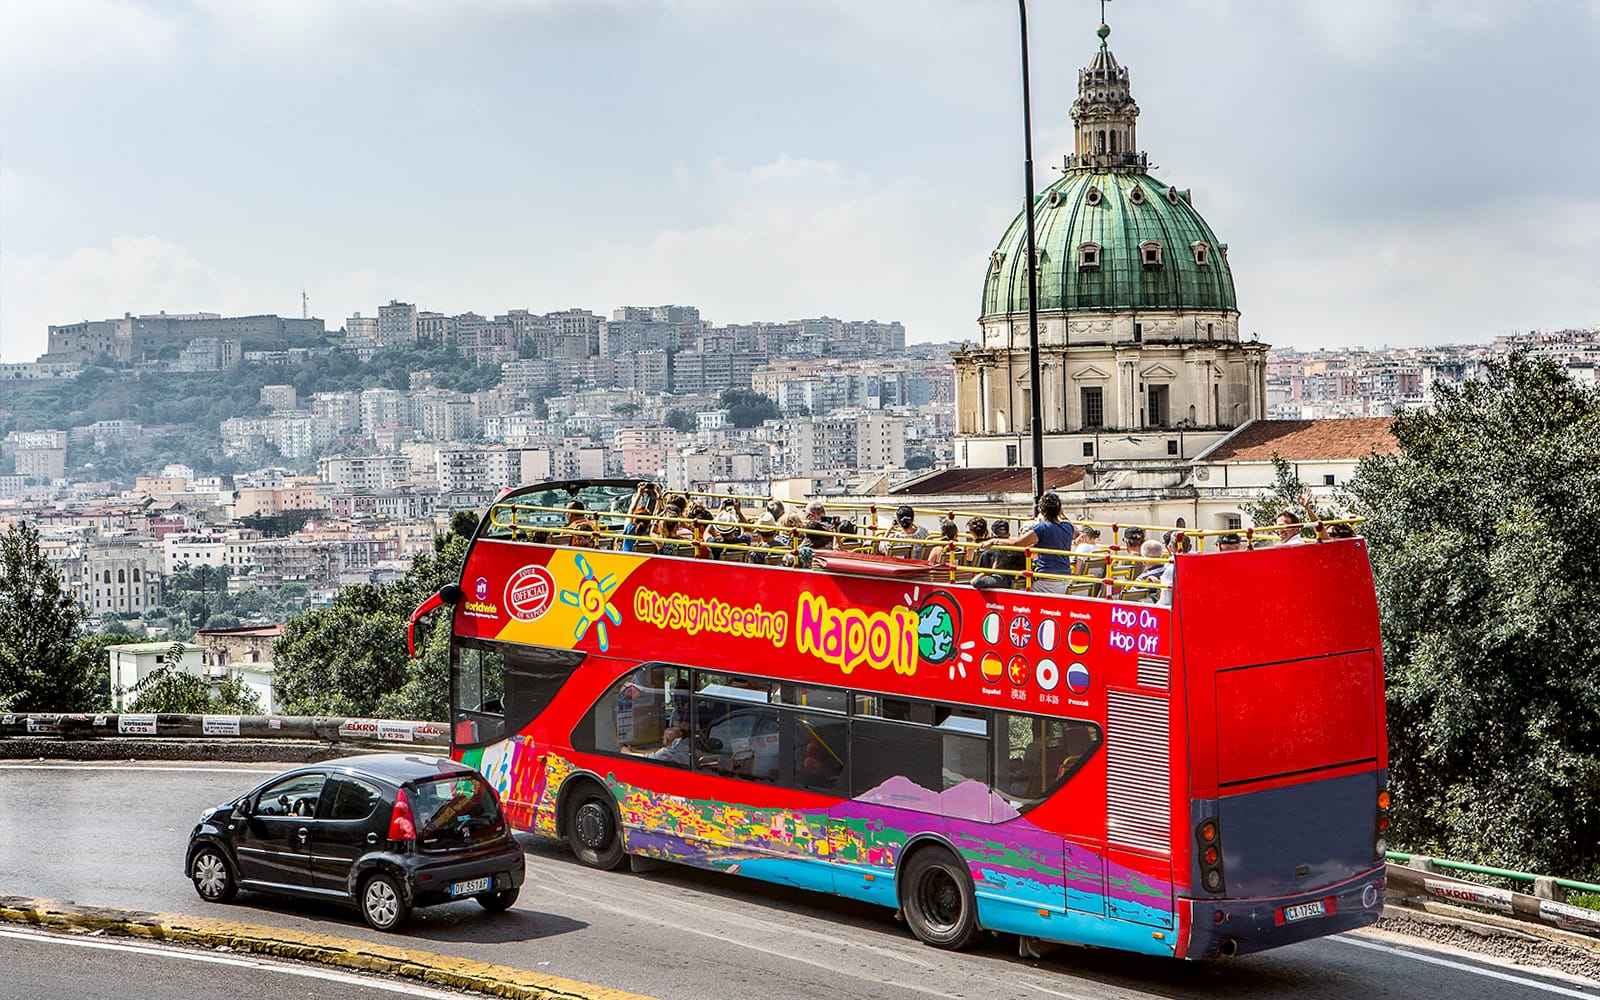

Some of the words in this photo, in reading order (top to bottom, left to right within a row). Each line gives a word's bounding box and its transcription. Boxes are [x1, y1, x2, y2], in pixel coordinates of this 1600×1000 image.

[513, 583, 547, 602] OFFICIAL
[1012, 605, 1032, 614] English
[1070, 611, 1091, 620] Deutsch
[1111, 606, 1137, 628] Hop
[1140, 609, 1158, 629] On
[796, 590, 919, 676] Napoli
[1109, 630, 1135, 652] Hop
[1138, 633, 1159, 653] Off
[1040, 693, 1060, 705] 日本語
[1434, 887, 1478, 901] ELKRON
